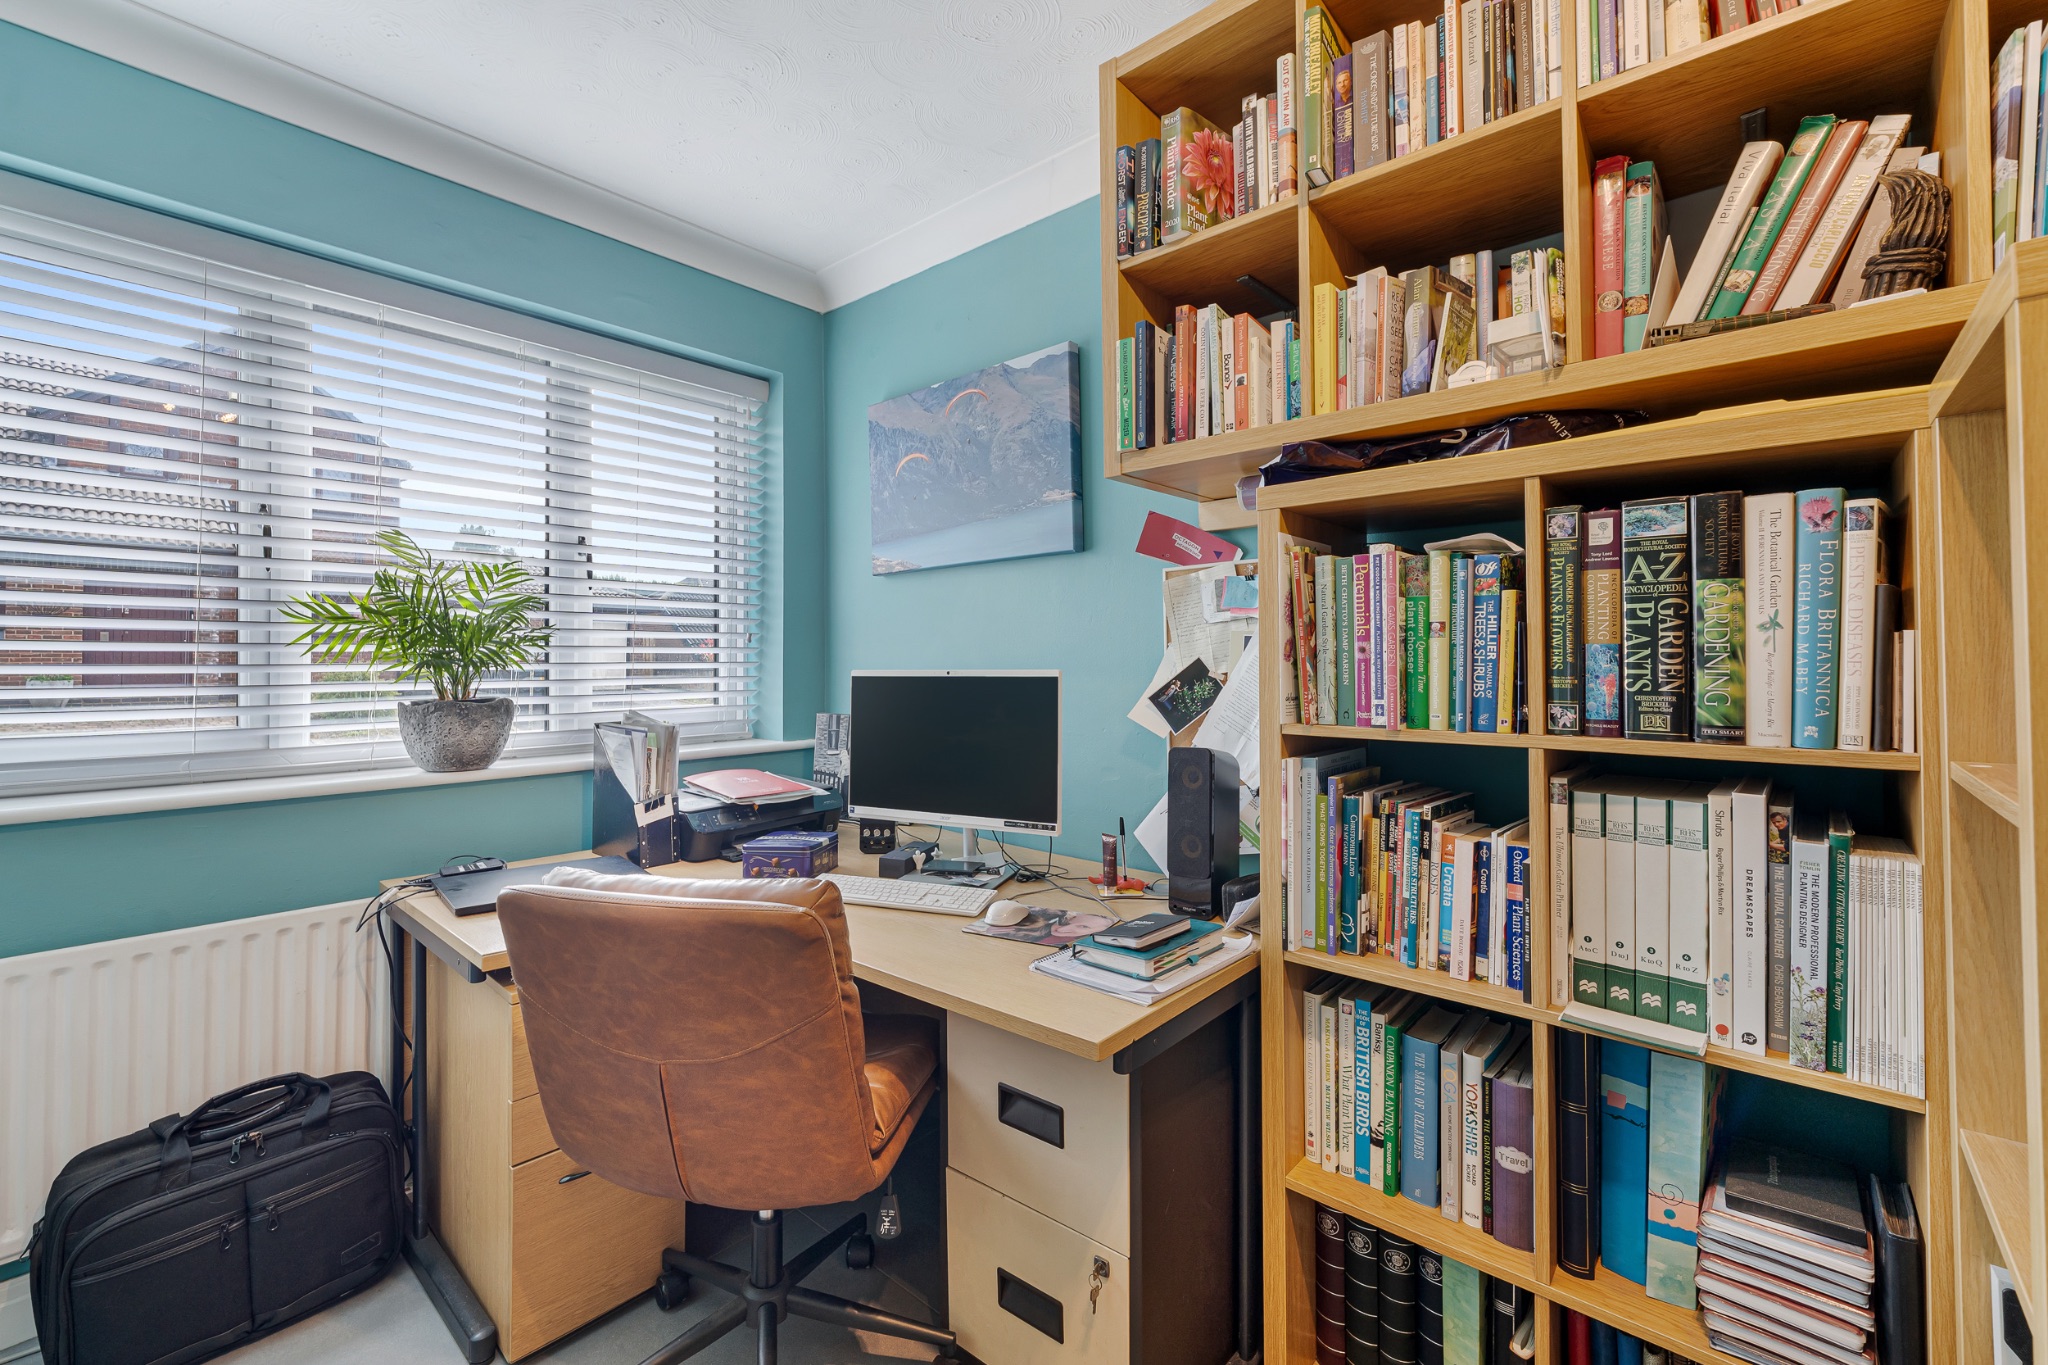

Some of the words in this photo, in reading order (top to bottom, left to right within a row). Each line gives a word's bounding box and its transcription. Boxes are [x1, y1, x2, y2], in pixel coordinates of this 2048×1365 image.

[1310, 14, 1320, 40] MIKE
[1468, 8, 1476, 35] Eddie
[1551, 14, 1560, 37] Birds
[1469, 34, 1478, 66] Izzard
[1283, 77, 1289, 88] OF
[1310, 42, 1321, 94] BREARLEY
[1336, 110, 1345, 144] CENTURY
[1167, 136, 1176, 169] Plant
[1738, 150, 1762, 179] Viva
[1166, 170, 1176, 210] Finder
[1718, 186, 1742, 224] Italia!
[1833, 195, 1844, 207] THE
[1838, 174, 1871, 216] ANTONIO
[1136, 192, 1149, 238] PRECIPICE
[1165, 217, 1180, 228] 2020
[1187, 203, 1208, 224] Plant
[1629, 197, 1642, 226] FISH
[1744, 173, 1791, 253] PASTA
[1754, 224, 1777, 260] COLLECTION
[1809, 218, 1848, 269] CARLUCCIO
[1810, 208, 1836, 248] COLLECTION
[1750, 196, 1815, 303] ENTERTAINING
[1628, 242, 1641, 293] SEAFOOD
[1413, 278, 1422, 300] Alan
[1413, 302, 1422, 338] Bennett
[1224, 354, 1232, 382] Bounce
[1292, 350, 1300, 380] PLACES
[1732, 512, 1740, 530] THE
[1769, 509, 1782, 528] The
[1174, 533, 1200, 552] OCTAGON
[1705, 518, 1714, 558] SOCIETY
[1718, 498, 1728, 576] HORTICULTURAL
[1732, 532, 1740, 562] ROYAL
[1769, 531, 1782, 572] Botanical
[1432, 557, 1442, 586] Carol
[1550, 557, 1564, 602] PLANTS
[1624, 552, 1688, 583] A-Z
[1818, 539, 1839, 598] FLORA
[1848, 546, 1866, 588] PESTS
[1320, 584, 1328, 610] Natural
[1355, 562, 1370, 636] Perennials
[1432, 588, 1442, 617] Klein
[1624, 584, 1688, 594] ENCYCLOPEDIA
[1768, 574, 1782, 608] Garden
[1798, 563, 1812, 635] RICHARD
[1849, 592, 1863, 602] &
[1406, 601, 1416, 628] plant
[1416, 601, 1426, 639] Gardeners'
[1474, 602, 1486, 638] TREES
[1552, 604, 1563, 613] &
[1598, 574, 1610, 640] PLANTING
[1320, 612, 1328, 636] Garden
[1487, 615, 1496, 659] HILLIER
[1612, 630, 1617, 640] OF
[1321, 638, 1329, 655] Style
[1408, 631, 1416, 674] chooser
[1416, 641, 1426, 672] Question
[1474, 638, 1485, 648] &
[1550, 614, 1564, 670] FLOWERS
[1624, 600, 1656, 692] PLANTS
[1658, 597, 1689, 694] GARDEN
[1703, 582, 1730, 706] GARDENING
[1846, 608, 1864, 677] DISEASES
[1473, 649, 1486, 698] SHRUBS
[1796, 643, 1808, 695] MABEY
[1815, 608, 1838, 718] BRITANNICA
[1417, 674, 1426, 693] Time
[1486, 690, 1492, 698] OF
[1556, 826, 1564, 840] The
[1580, 818, 1595, 826] RHS
[1644, 824, 1660, 832] RHS
[1680, 828, 1696, 836] RHS
[1714, 810, 1725, 837] Shrubs
[1349, 856, 1357, 877] LLOYD
[1513, 850, 1522, 882] Oxford
[1555, 841, 1564, 868] Ultimate
[1430, 861, 1439, 896] ROSES
[1442, 866, 1454, 906] Croatia
[1480, 868, 1488, 894] Croatia
[1556, 869, 1564, 893] Garden
[1774, 866, 1784, 880] THE
[1812, 874, 1820, 888] THE
[1410, 878, 1418, 924] STRUCTURES
[1556, 894, 1564, 918] Planner
[1746, 869, 1754, 938] DREAMSCAPES
[1774, 882, 1784, 916] NATURAL
[1800, 872, 1808, 909] PLANTING
[1512, 904, 1524, 934] Plant
[1811, 890, 1819, 924] MODERN
[1774, 918, 1784, 958] GARDENER
[1799, 910, 1807, 948] DESIGNER
[1512, 936, 1524, 981] Sciences
[1810, 924, 1818, 980] PROFESSIONAL
[1774, 964, 1784, 984] CHRIS
[1774, 986, 1784, 1028] BEARDSHAW
[1374, 1022, 1382, 1054] Banksy
[1356, 1026, 1370, 1088] BRITISH
[1386, 1035, 1394, 1087] COMPANION
[1414, 1052, 1424, 1068] THE
[1342, 1064, 1352, 1091] What
[1414, 1070, 1424, 1096] SAGAS
[1444, 1062, 1456, 1104] YOGA
[1342, 1093, 1352, 1118] Plant
[1356, 1090, 1370, 1136] BIRDS
[1385, 1088, 1394, 1136] PLANTING
[1414, 1098, 1424, 1109] OF
[1466, 1083, 1478, 1156] YORKSHIRE
[1342, 1120, 1352, 1152] Where
[1414, 1110, 1424, 1160] ICELANDERS
[1498, 1152, 1528, 1168] Travel
